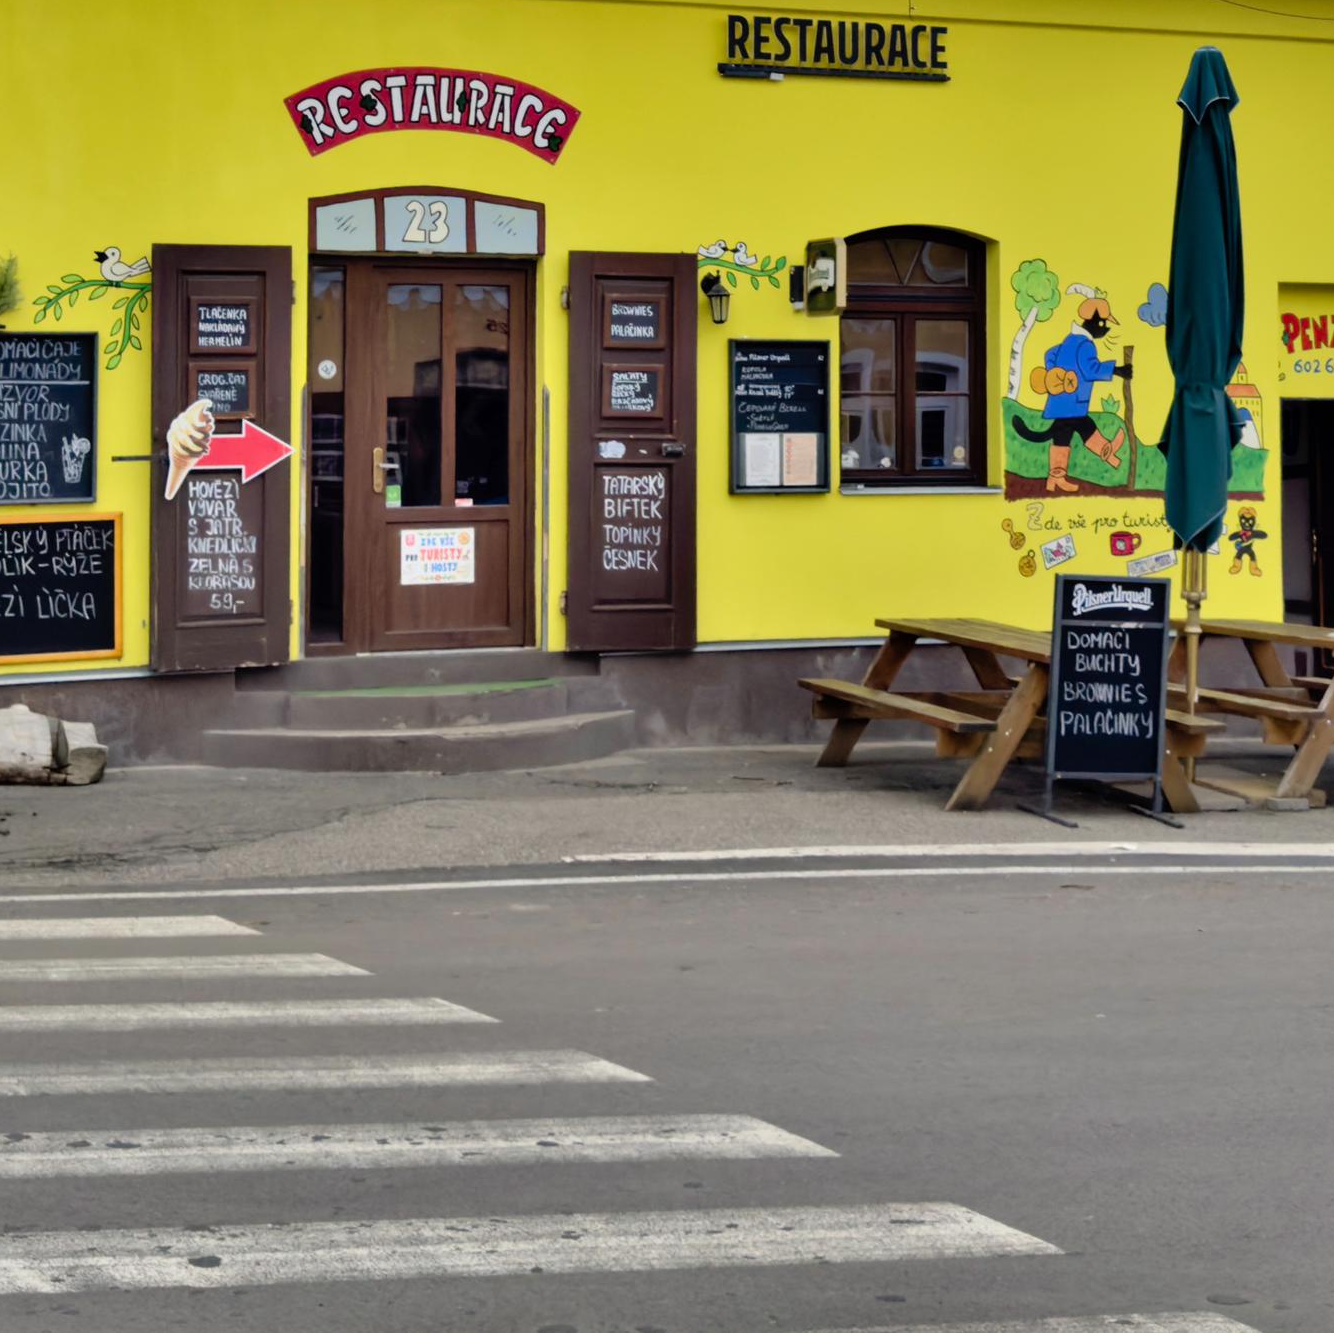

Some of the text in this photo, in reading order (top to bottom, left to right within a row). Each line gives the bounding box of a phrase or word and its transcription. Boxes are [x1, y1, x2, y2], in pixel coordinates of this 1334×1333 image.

[728, 15, 948, 69] RESTAURACE
[296, 74, 567, 150] RESTAURACE
[402, 200, 451, 244] 23
[198, 306, 247, 320] TLAČENKA
[612, 304, 653, 317] BROWNIES
[611, 323, 654, 338] PALAČINKA
[0, 359, 81, 380] LIMONÁDY
[1293, 359, 1320, 373] 602
[24, 402, 70, 422] PLODY
[603, 472, 665, 499] TATARSKÝ
[604, 498, 662, 519] BIFTEK
[1091, 516, 1118, 534] pro
[1122, 509, 1171, 534] turist
[603, 545, 658, 571] ČESNEK
[1072, 583, 1153, 616] Pilsner Urquell
[1075, 653, 1141, 676] BUCHTY
[1064, 681, 1148, 704] BROWNIES
[1060, 709, 1154, 738] PALAČINKY
